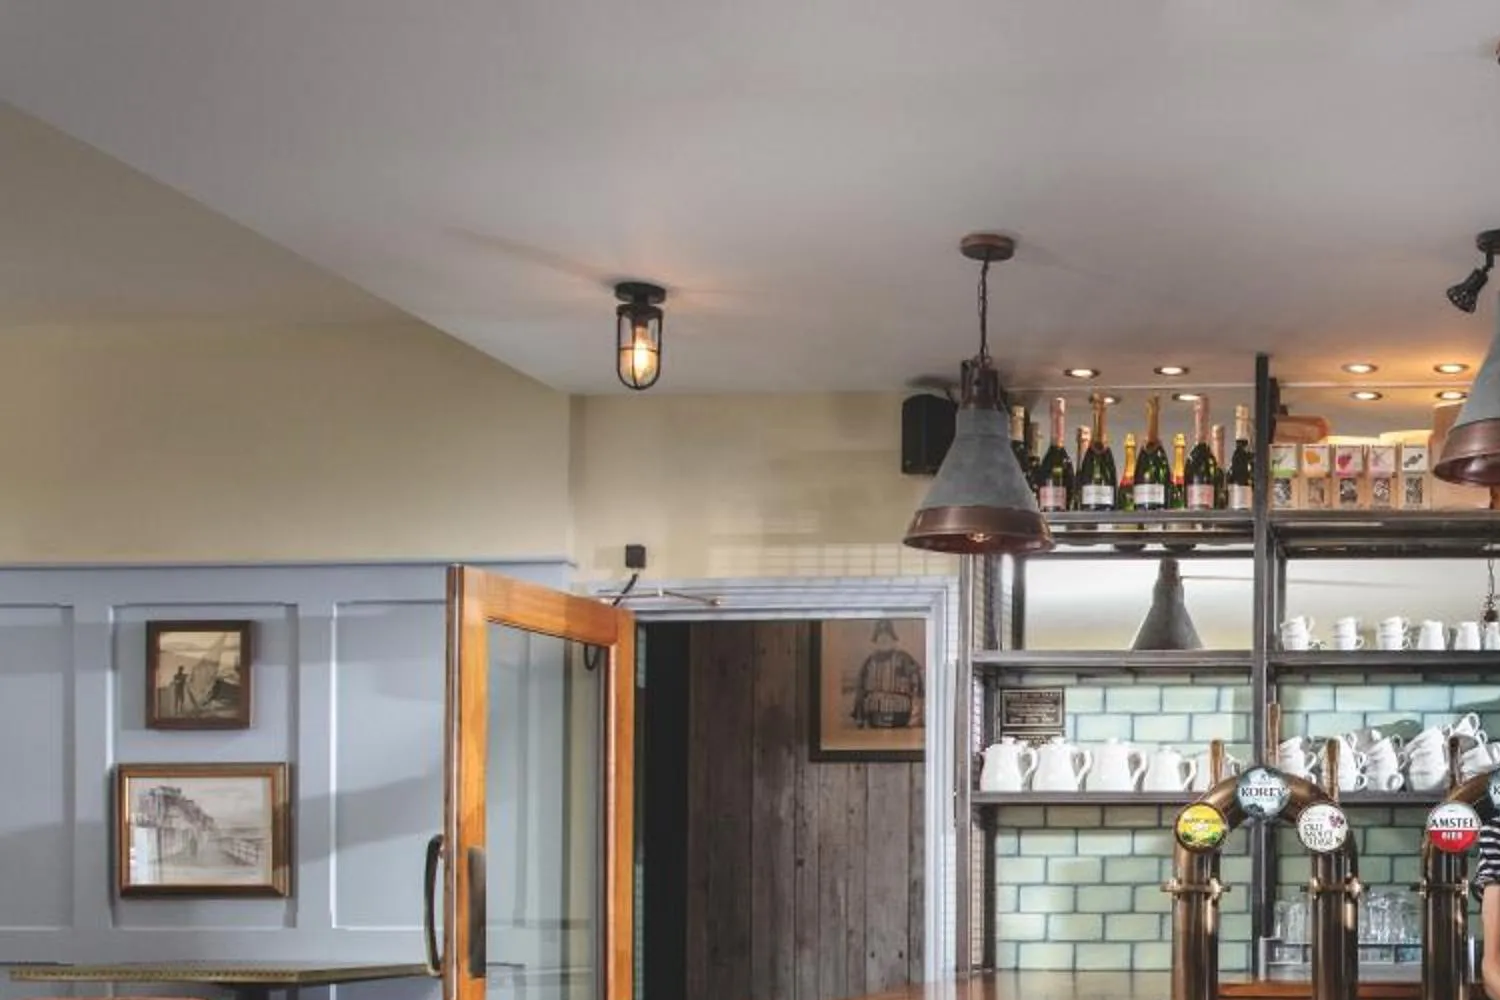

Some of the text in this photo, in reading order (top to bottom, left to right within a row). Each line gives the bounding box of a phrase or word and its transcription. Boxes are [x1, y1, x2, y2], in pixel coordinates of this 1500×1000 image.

[1241, 787, 1286, 797] KOREV
[1431, 817, 1474, 828] AMSTEL
[1441, 832, 1463, 840] BIER
